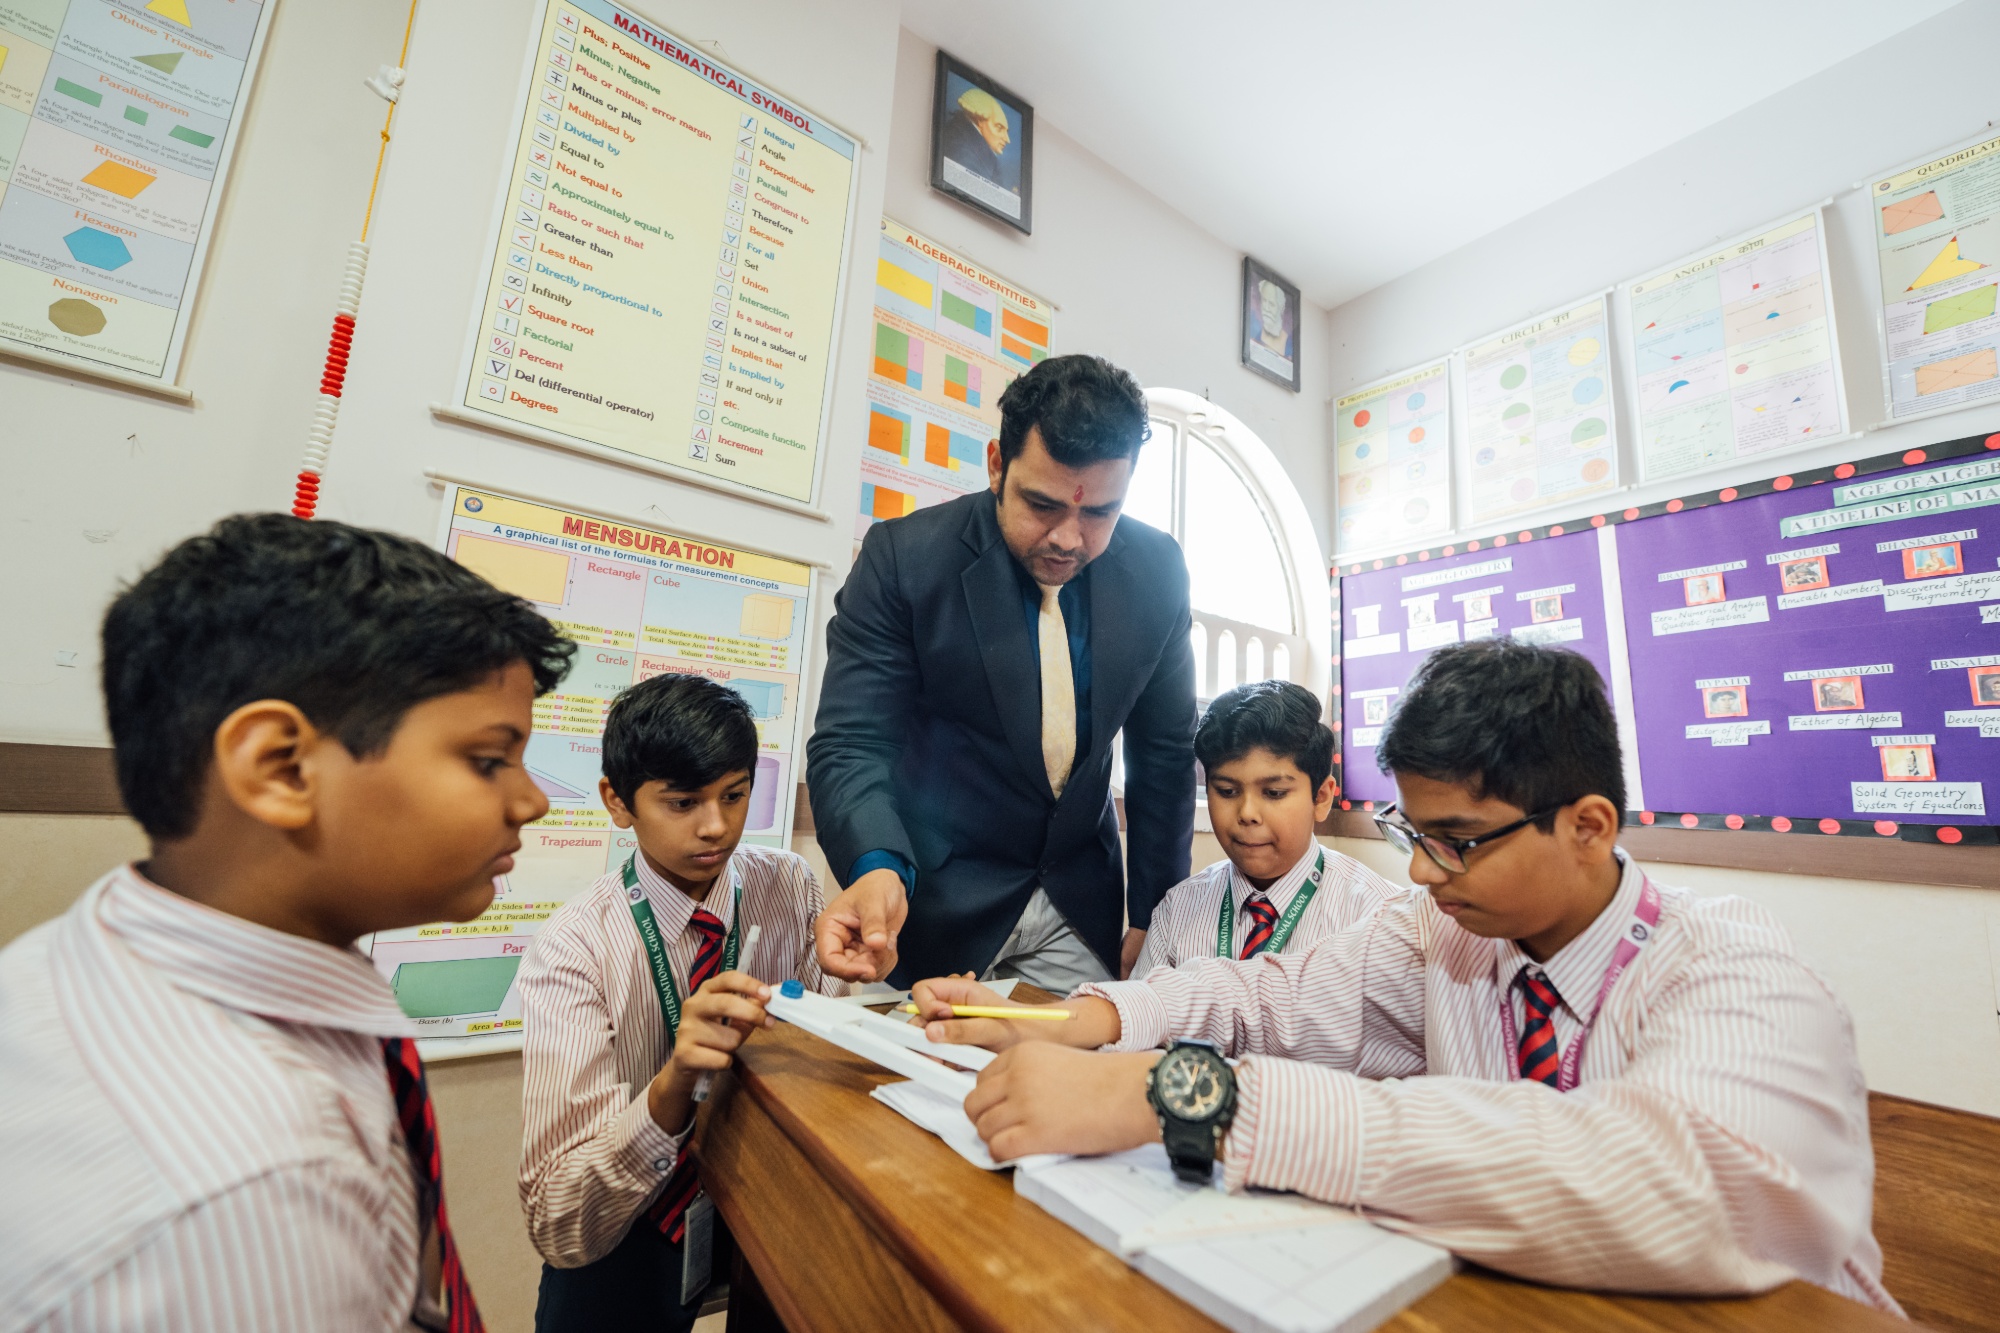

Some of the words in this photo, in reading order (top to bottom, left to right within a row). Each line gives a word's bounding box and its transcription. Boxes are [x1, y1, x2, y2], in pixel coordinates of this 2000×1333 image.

[110, 9, 157, 35] Obtuse
[163, 31, 214, 60] Triangle
[582, 25, 608, 48] Plus;
[611, 41, 651, 71] Positive
[579, 43, 614, 71] Minus;
[617, 64, 661, 96] Negative
[613, 13, 746, 97] MATHEMATICAL
[751, 91, 812, 133] SYMBOL
[98, 74, 189, 117] Parallelogram
[571, 82, 604, 106] Minus
[606, 103, 619, 113] or
[620, 110, 642, 126] plus
[575, 63, 598, 82] Plus
[600, 79, 613, 90] or
[614, 86, 648, 110] minus;
[651, 106, 677, 122] error
[678, 119, 712, 141] margin
[567, 101, 620, 135] Multiplied
[622, 129, 636, 143] by
[563, 121, 605, 148] Divided
[607, 142, 621, 157] by
[763, 126, 796, 151] Integral
[93, 143, 157, 175] Rhombus
[559, 140, 591, 163] Equal
[593, 157, 605, 169] to
[760, 143, 786, 162] Angle
[555, 160, 577, 178] Not
[579, 174, 609, 192] equal
[611, 187, 623, 199] to
[756, 175, 788, 198] Parallel
[758, 158, 816, 194] Perpendicular
[551, 181, 632, 224] Approximately
[633, 219, 662, 235] equal
[663, 229, 675, 240] to
[751, 208, 794, 235] Therefore
[753, 192, 799, 220] Congruent
[800, 215, 810, 225] to
[73, 209, 138, 238] Hexagon
[547, 201, 578, 222] Ratio
[580, 218, 594, 228] or
[595, 225, 620, 241] such
[623, 235, 644, 250] that
[748, 225, 785, 248] Because
[543, 222, 587, 247] Greater
[589, 241, 614, 259] than
[746, 241, 762, 255] For
[763, 251, 775, 261] all
[539, 242, 566, 260] Less
[568, 255, 593, 272] than
[743, 258, 759, 272] Set
[1673, 255, 1725, 280] ANGLES
[741, 275, 769, 294] Union
[905, 235, 975, 279] ALGEBRAIC
[978, 273, 1037, 309] IDENTITIES
[51, 277, 118, 305] Nonagon
[531, 282, 573, 307] Infinity
[535, 262, 580, 288] Directly
[582, 282, 650, 313] proportional
[651, 307, 663, 318] to
[738, 292, 790, 320] Intersection
[527, 304, 568, 327] Square
[570, 322, 595, 337] root
[736, 309, 744, 320] Is
[754, 319, 782, 335] subset
[783, 331, 794, 339] of
[1501, 321, 1546, 344] CIRCLE
[522, 326, 574, 352] Factorial
[733, 327, 742, 337] Is
[743, 333, 759, 344] not
[769, 343, 796, 358] subset
[798, 354, 807, 362] of
[518, 347, 564, 372] Percent
[730, 344, 763, 363] Implies
[765, 357, 783, 370] that
[728, 361, 737, 372] Is
[738, 366, 772, 384] implied
[773, 377, 785, 390] by
[509, 390, 559, 414] Degrees
[514, 368, 536, 384] Del
[538, 376, 603, 405] (differential
[605, 400, 655, 422] operator)
[722, 400, 740, 411] etc.
[725, 379, 734, 389] If
[735, 385, 753, 396] and
[754, 392, 774, 404] only
[775, 397, 783, 406] if
[717, 434, 764, 456] Increment
[720, 416, 770, 439] Composite
[771, 432, 806, 451] function
[714, 453, 736, 467] Sum
[1846, 482, 1888, 500] AGE
[1893, 477, 1921, 491] OF
[1791, 522, 1803, 531] A
[1808, 502, 1909, 528] TIMELINE
[1916, 496, 1945, 510] OF
[562, 516, 735, 569] MENSURATION
[1768, 553, 1790, 563] IBN
[1792, 545, 1840, 558] QURRA
[1878, 534, 1959, 552] BHASKARA
[1964, 531, 1974, 539] II
[493, 525, 502, 534] A
[505, 528, 558, 546] graphical
[561, 540, 578, 550] list
[580, 544, 592, 553] of
[593, 546, 611, 557] the
[613, 550, 657, 566] formulas
[659, 559, 674, 569] for
[675, 565, 738, 582] measurement
[740, 577, 780, 590] concepts
[587, 561, 641, 581] Rectangle
[1659, 561, 1745, 581] BRAHMAGUPTA
[652, 575, 681, 588] Cube
[1833, 584, 1882, 597] Numbers
[1887, 581, 1947, 597] Discovered
[1679, 604, 1727, 619] Numerical
[595, 653, 629, 666] Circle
[641, 659, 703, 675] Rectangular
[706, 668, 731, 680] Solid
[1786, 665, 1891, 680] AL-KHWARIZMI
[1698, 678, 1749, 687] HYPATIA
[1721, 725, 1734, 738] of
[1734, 722, 1765, 735] Great
[1792, 717, 1833, 727] Father
[1837, 714, 1851, 726] of
[1856, 713, 1900, 728] Algebra
[1874, 736, 1898, 744] LIU
[1903, 735, 1931, 744] HUI
[1855, 785, 1888, 798] Solid
[1894, 786, 1966, 801] Geometry
[1857, 800, 1898, 812] System
[1903, 800, 1916, 812] of
[1921, 800, 1983, 813] Equations
[540, 835, 602, 848] Trapezium
[1287, 892, 1308, 920] SCHOOL
[641, 917, 661, 952] SCHOOL
[653, 951, 681, 1026] INTERNATIONAL
